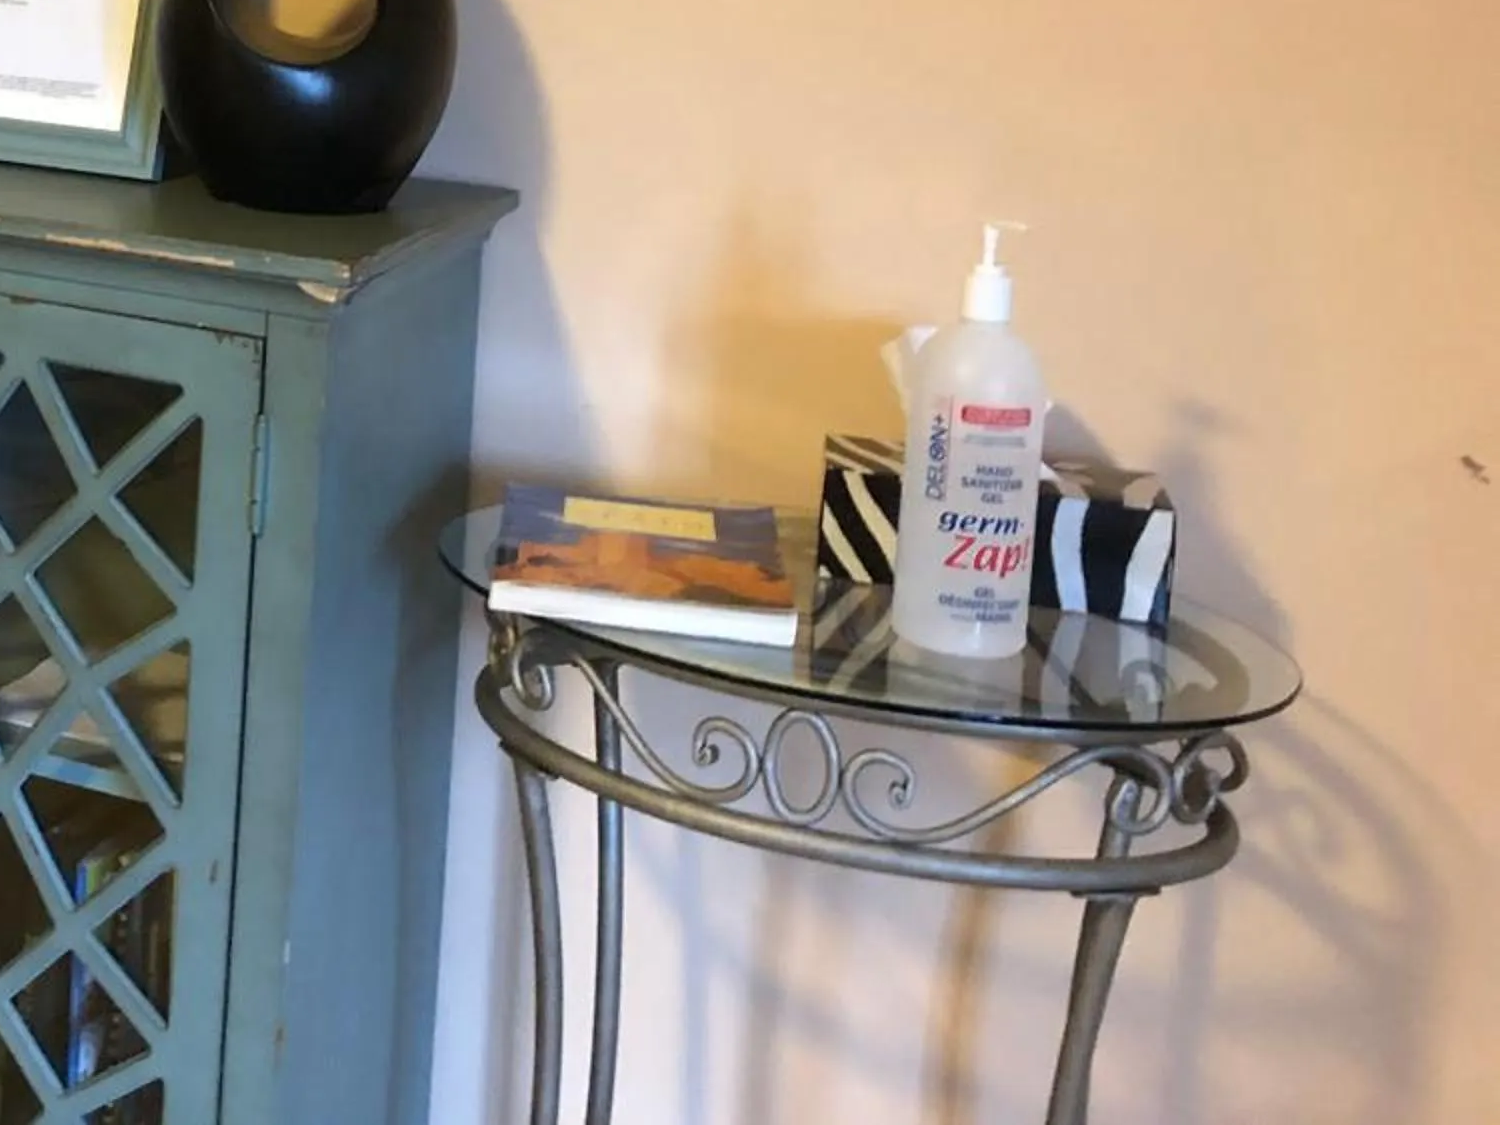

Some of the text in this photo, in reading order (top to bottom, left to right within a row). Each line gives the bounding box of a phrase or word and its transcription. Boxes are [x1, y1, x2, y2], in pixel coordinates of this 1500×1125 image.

[976, 465, 1013, 476] HAND
[981, 492, 1004, 504] GEL
[943, 534, 1031, 579] Zap!
